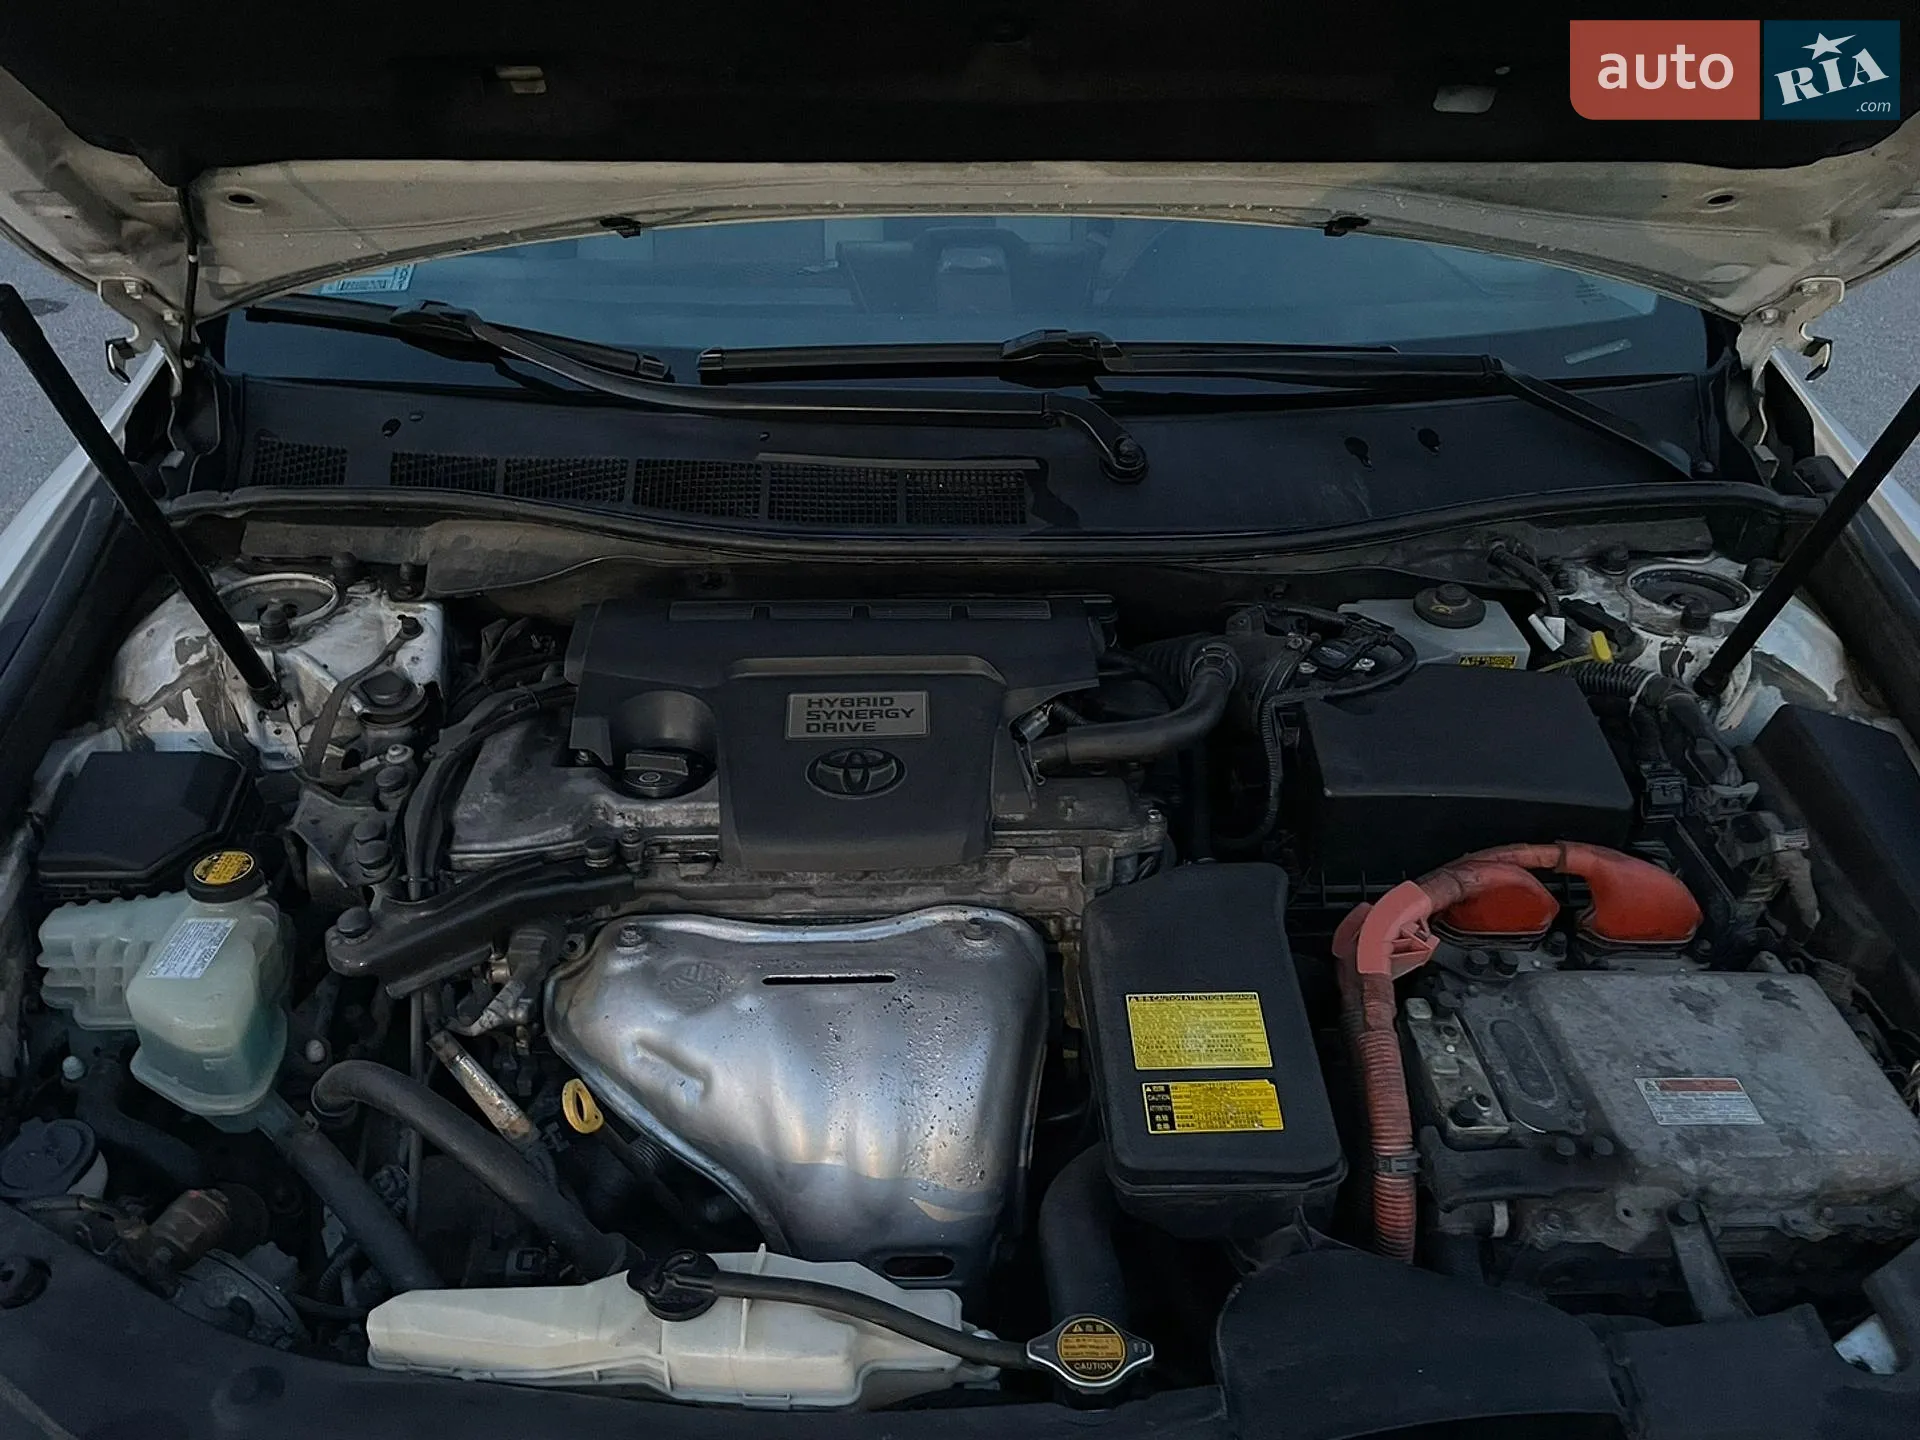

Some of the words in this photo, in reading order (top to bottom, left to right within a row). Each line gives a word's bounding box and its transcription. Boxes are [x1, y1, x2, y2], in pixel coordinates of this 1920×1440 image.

[807, 697, 895, 708] HYBRID
[806, 708, 915, 720] SYNERGY
[806, 722, 877, 733] DRIVE
[1074, 1361, 1114, 1370] CAUTION
